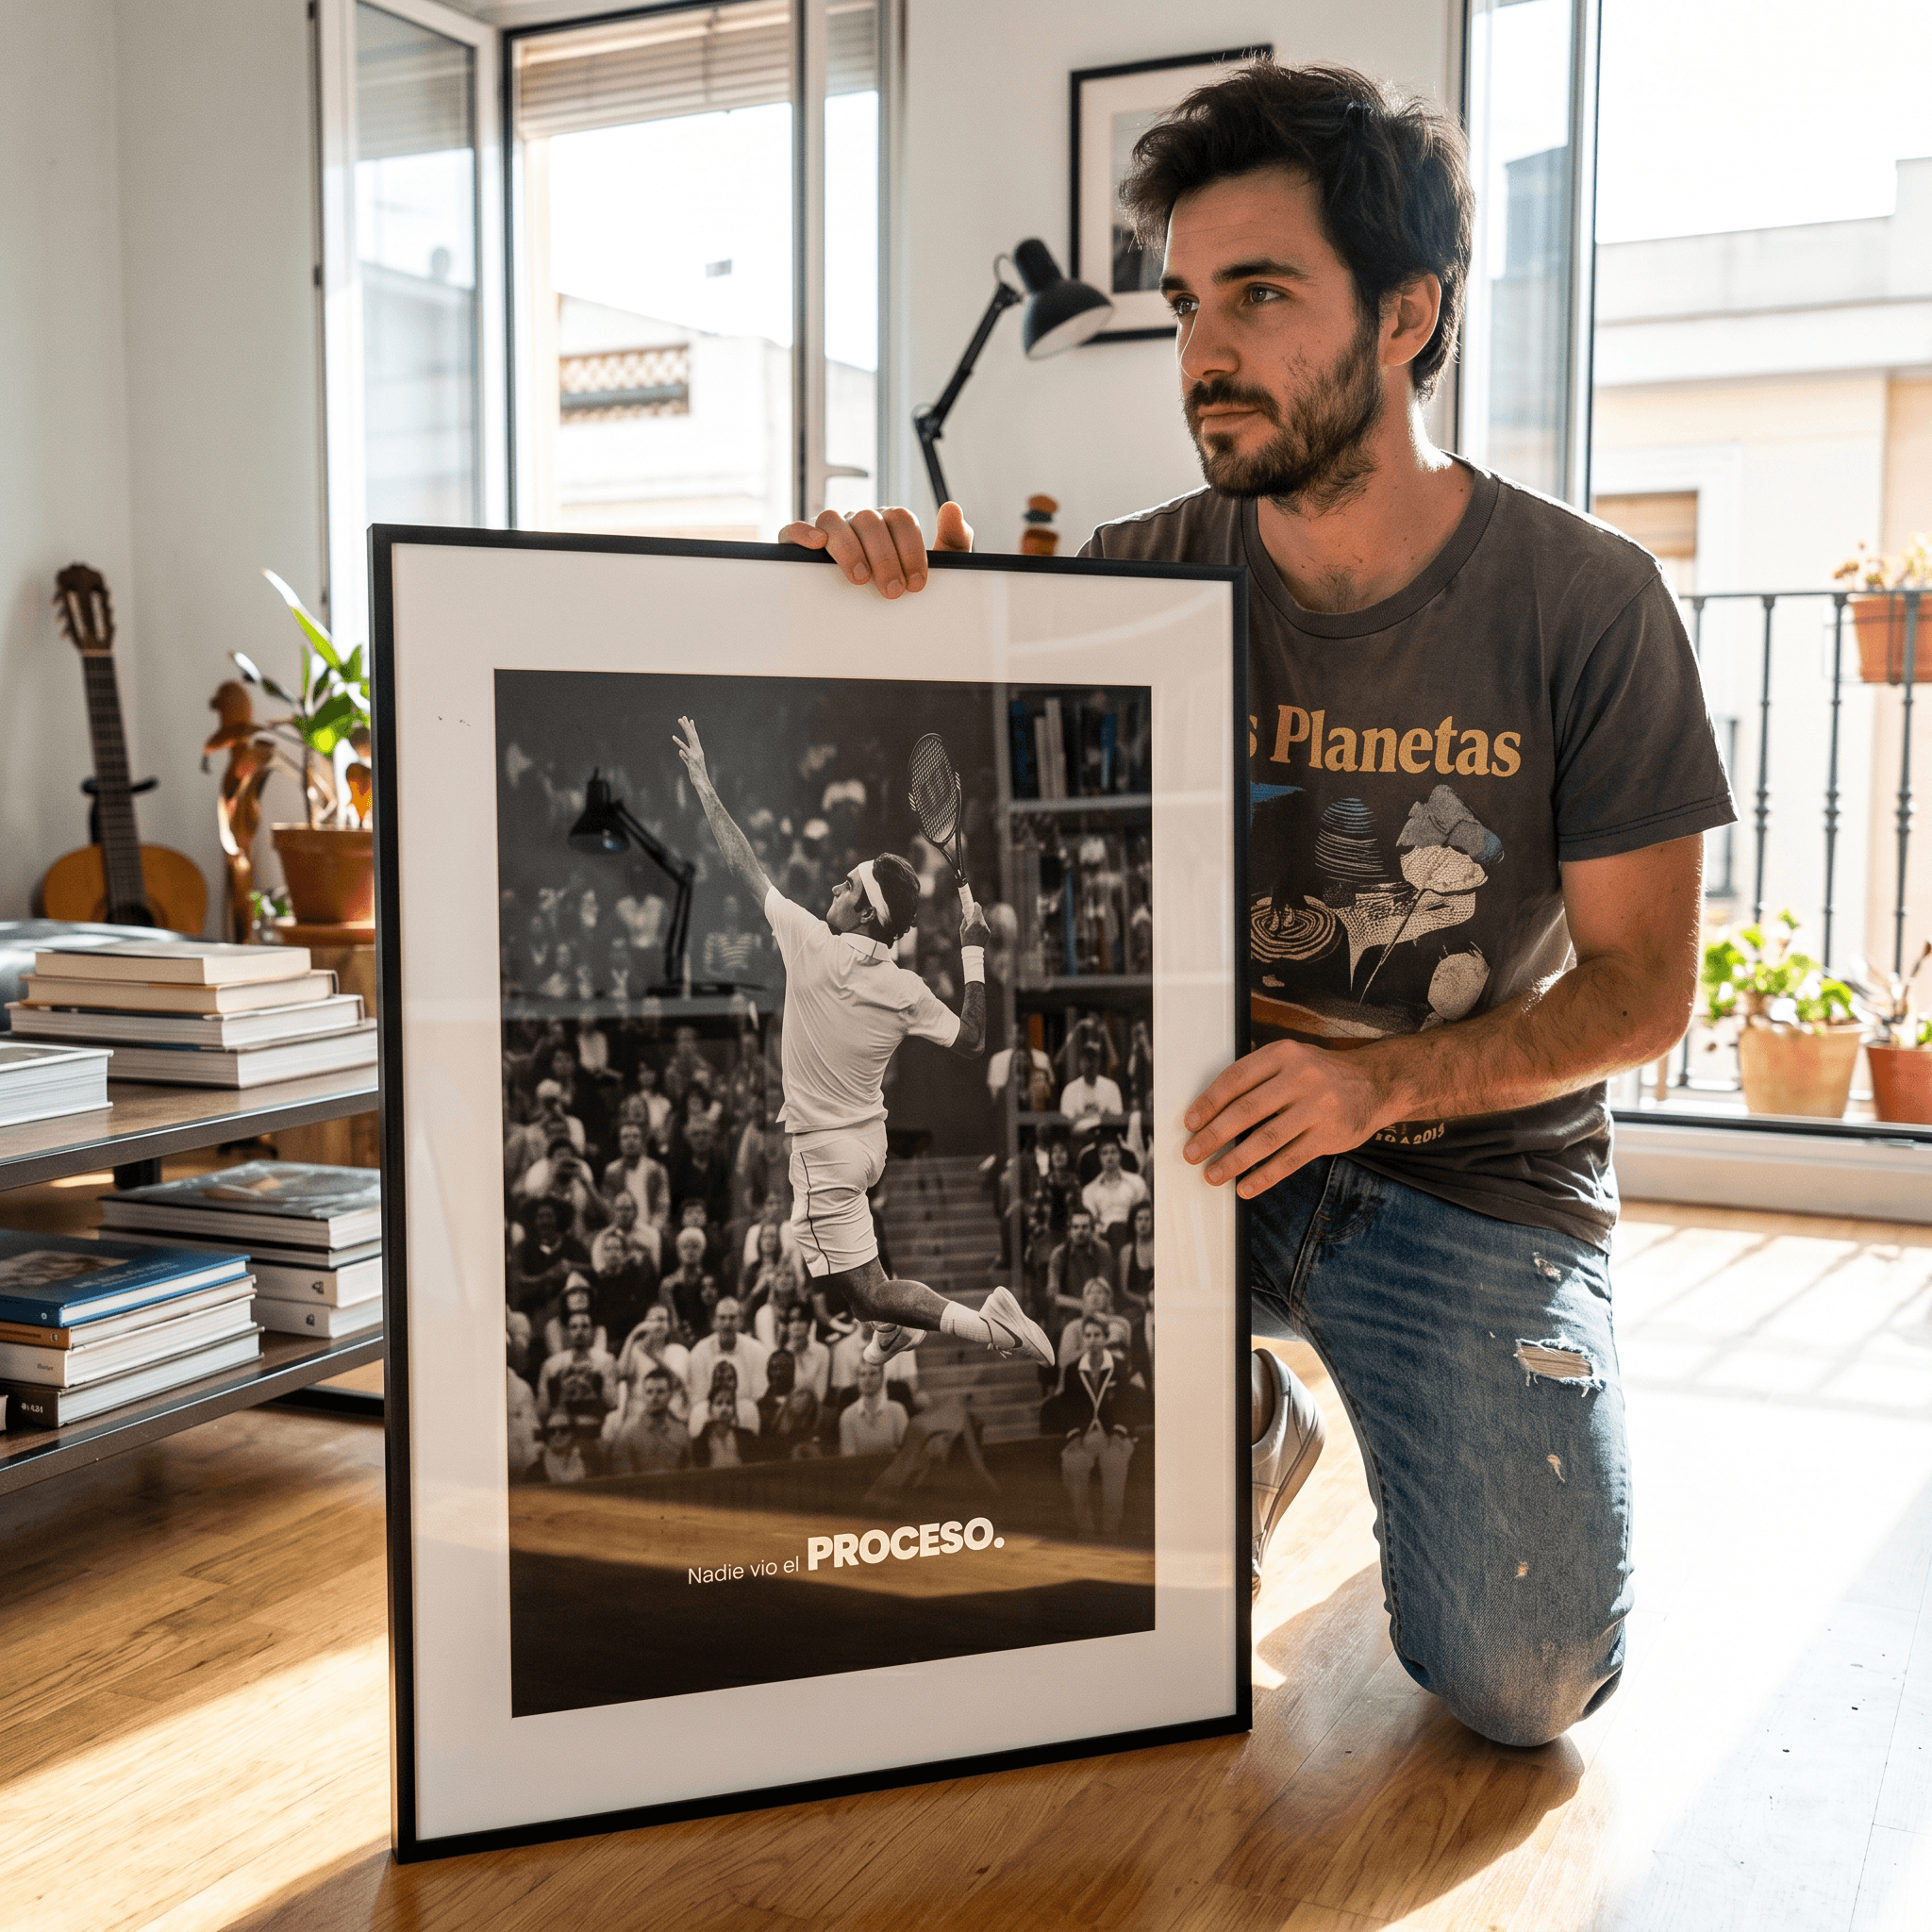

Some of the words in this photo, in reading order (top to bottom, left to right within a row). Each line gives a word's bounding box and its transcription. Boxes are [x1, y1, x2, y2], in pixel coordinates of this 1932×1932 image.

[1270, 705, 1522, 777] Planetas
[688, 1564, 744, 1585] Nadie
[750, 1559, 777, 1576] vio
[783, 1556, 799, 1573] el
[807, 1517, 1005, 1571] PROCESO.
